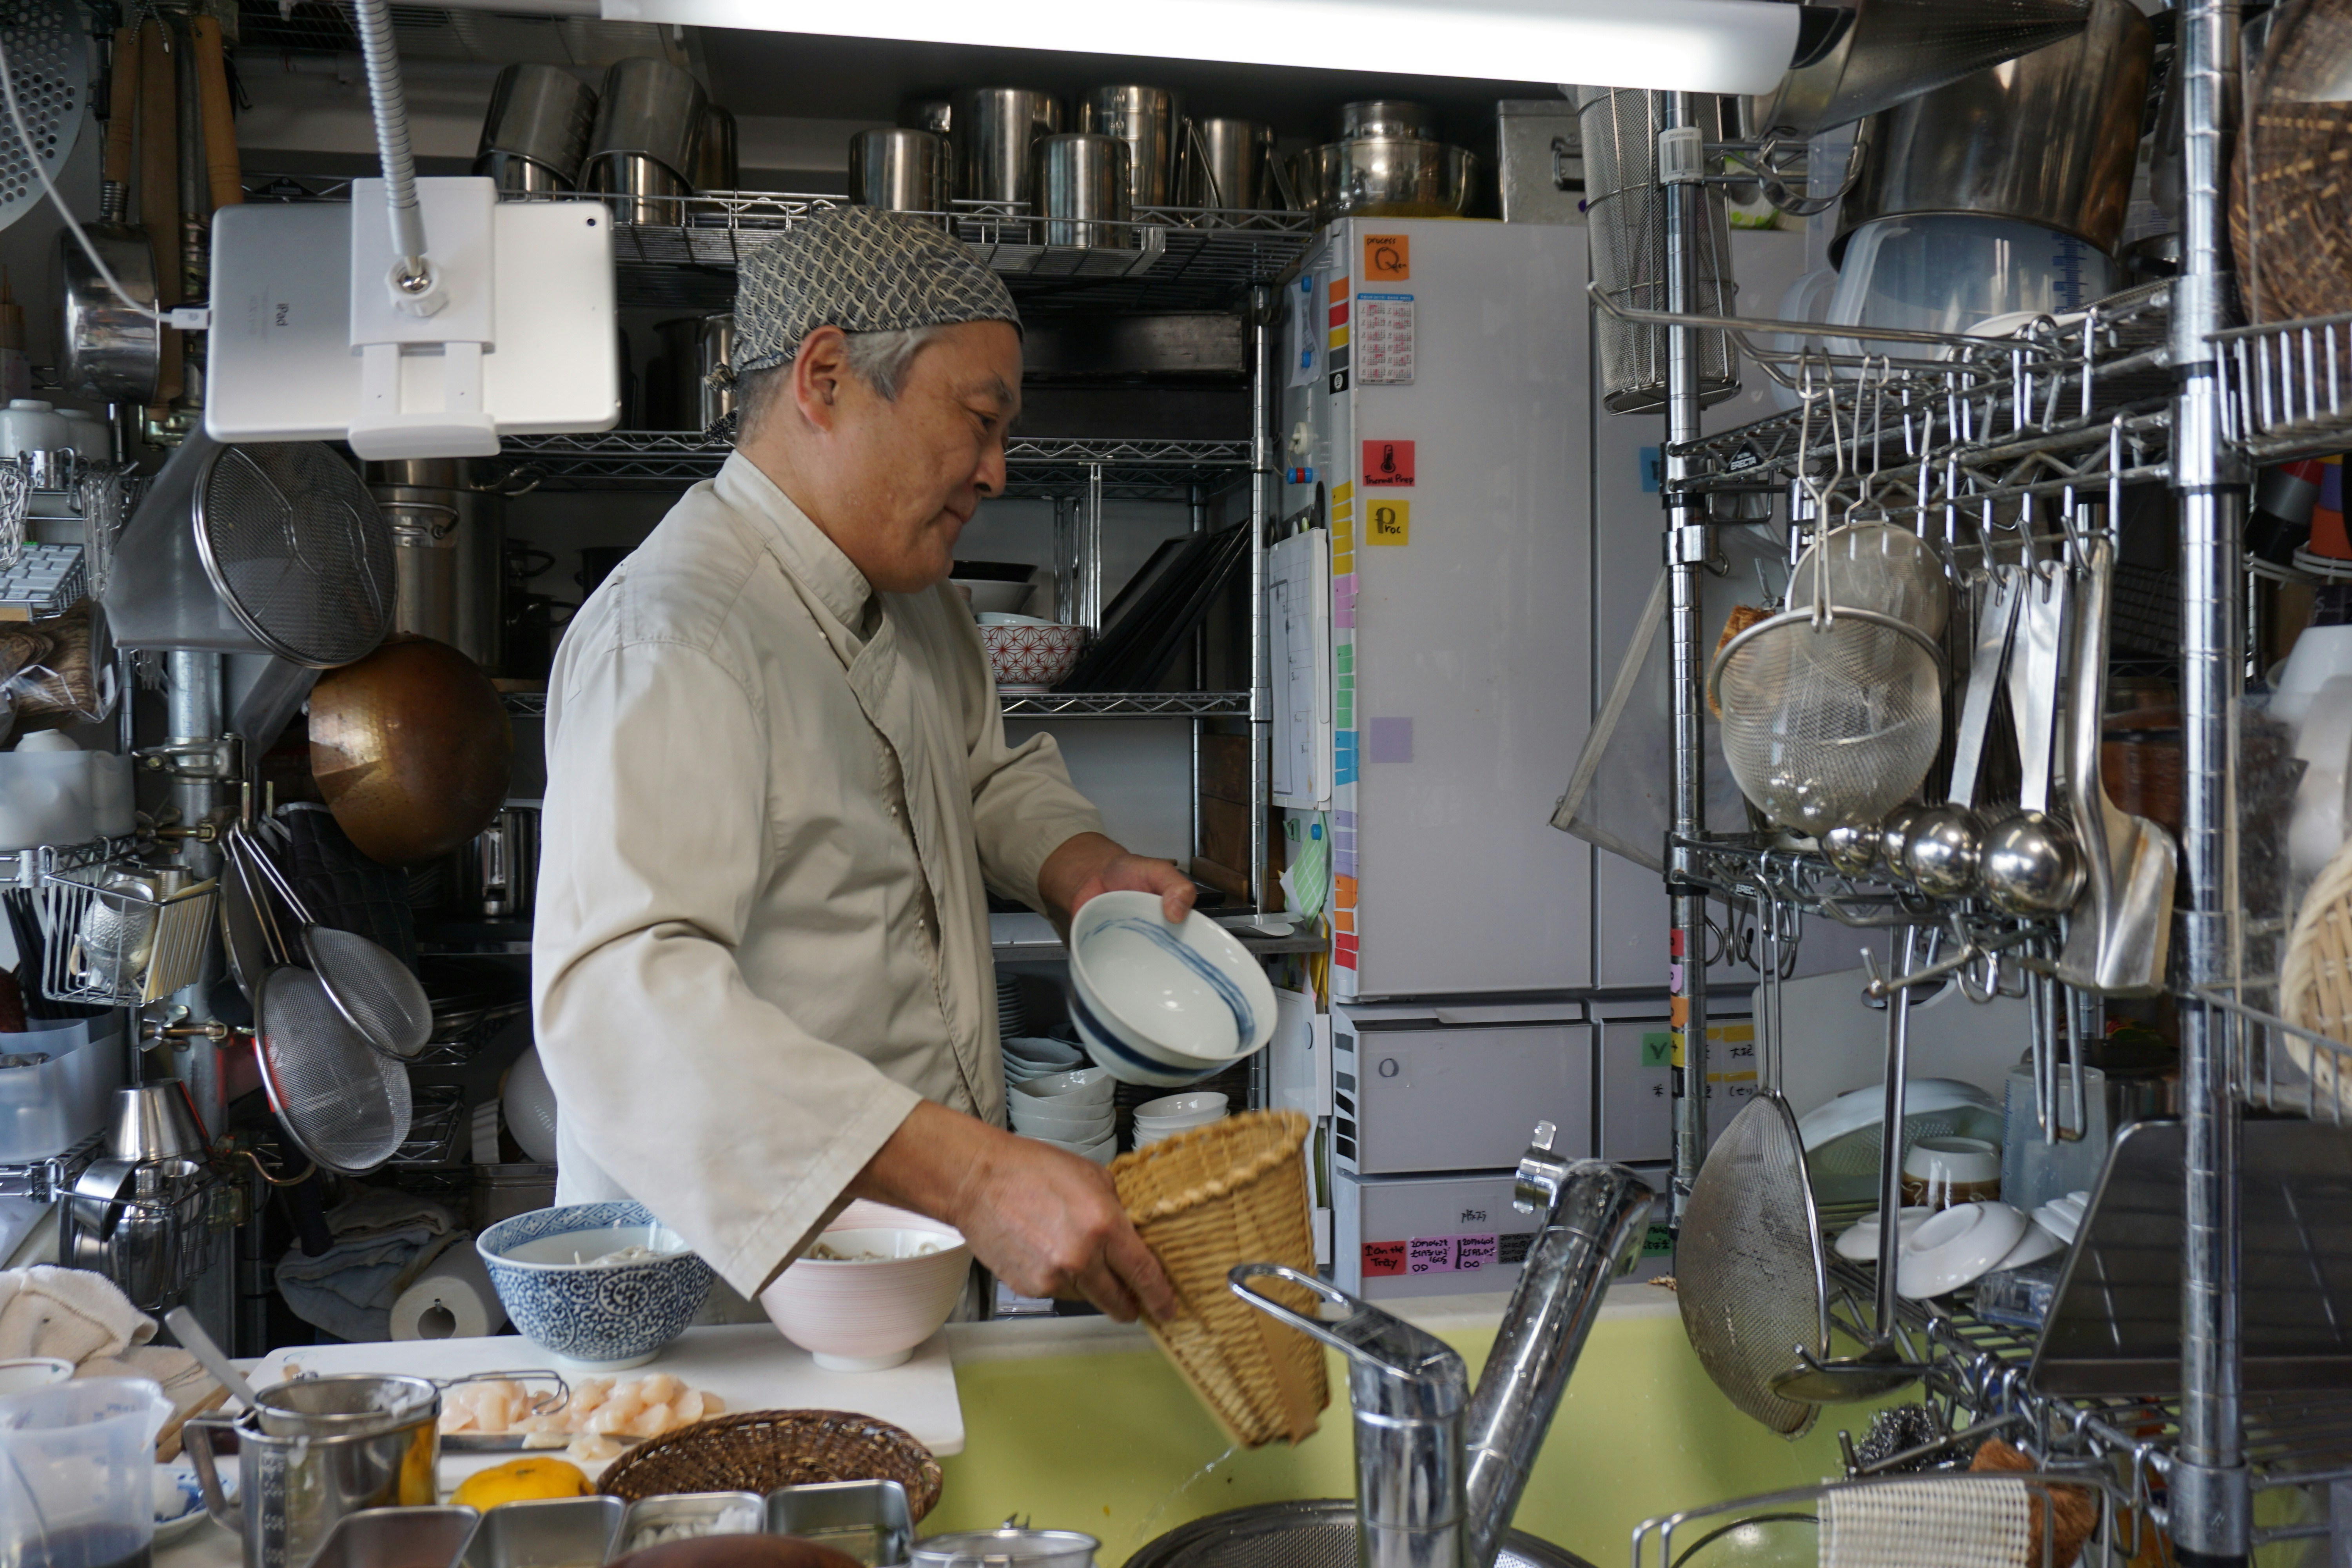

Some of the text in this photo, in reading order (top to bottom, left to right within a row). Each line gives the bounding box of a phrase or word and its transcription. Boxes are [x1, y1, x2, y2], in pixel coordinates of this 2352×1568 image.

[276, 303, 289, 327] iPad
[1731, 456, 1757, 470] ERECTA
[1365, 474, 1414, 485] Thermal Prep
[1375, 507, 1401, 534] Proc
[1390, 1245, 1404, 1254] the
[1370, 1258, 1398, 1270] Tray
